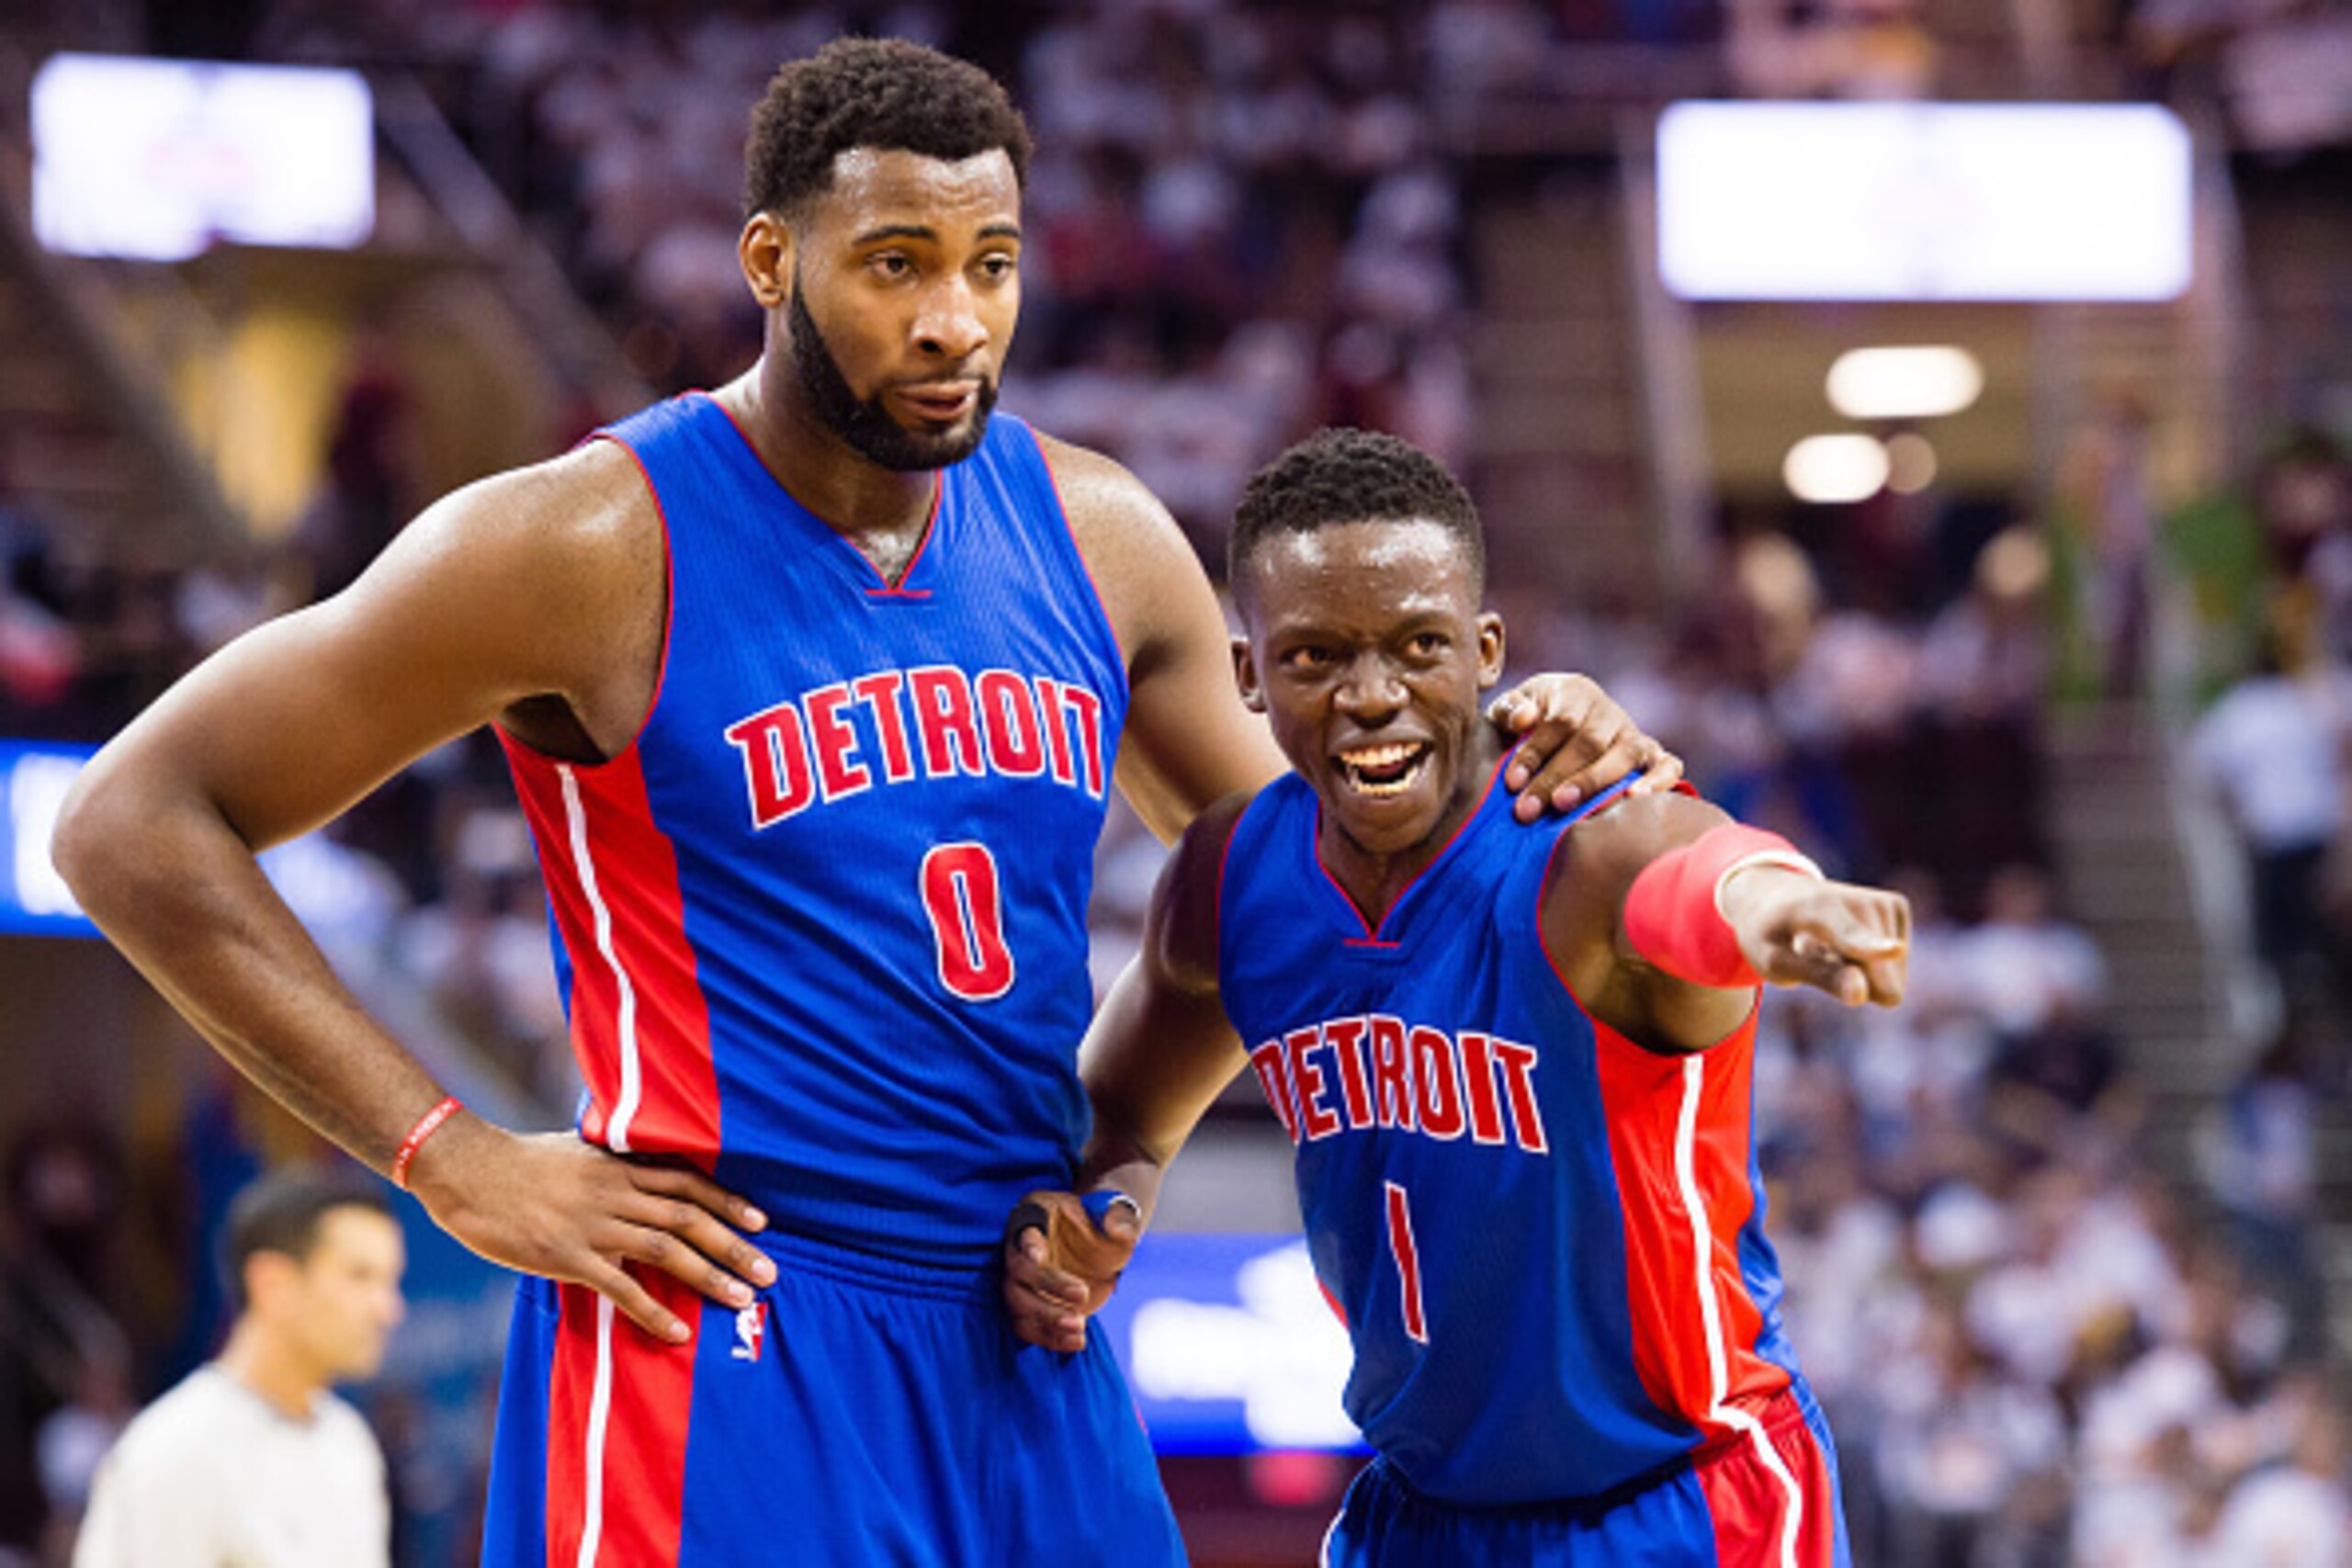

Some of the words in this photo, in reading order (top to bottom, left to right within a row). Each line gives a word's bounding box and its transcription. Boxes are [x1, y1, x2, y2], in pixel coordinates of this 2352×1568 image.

[725, 665, 1102, 830] DETROIT
[920, 840, 1014, 1001] 0
[1250, 1014, 1549, 1154] DETROIT
[1385, 1179, 1429, 1343] 1
